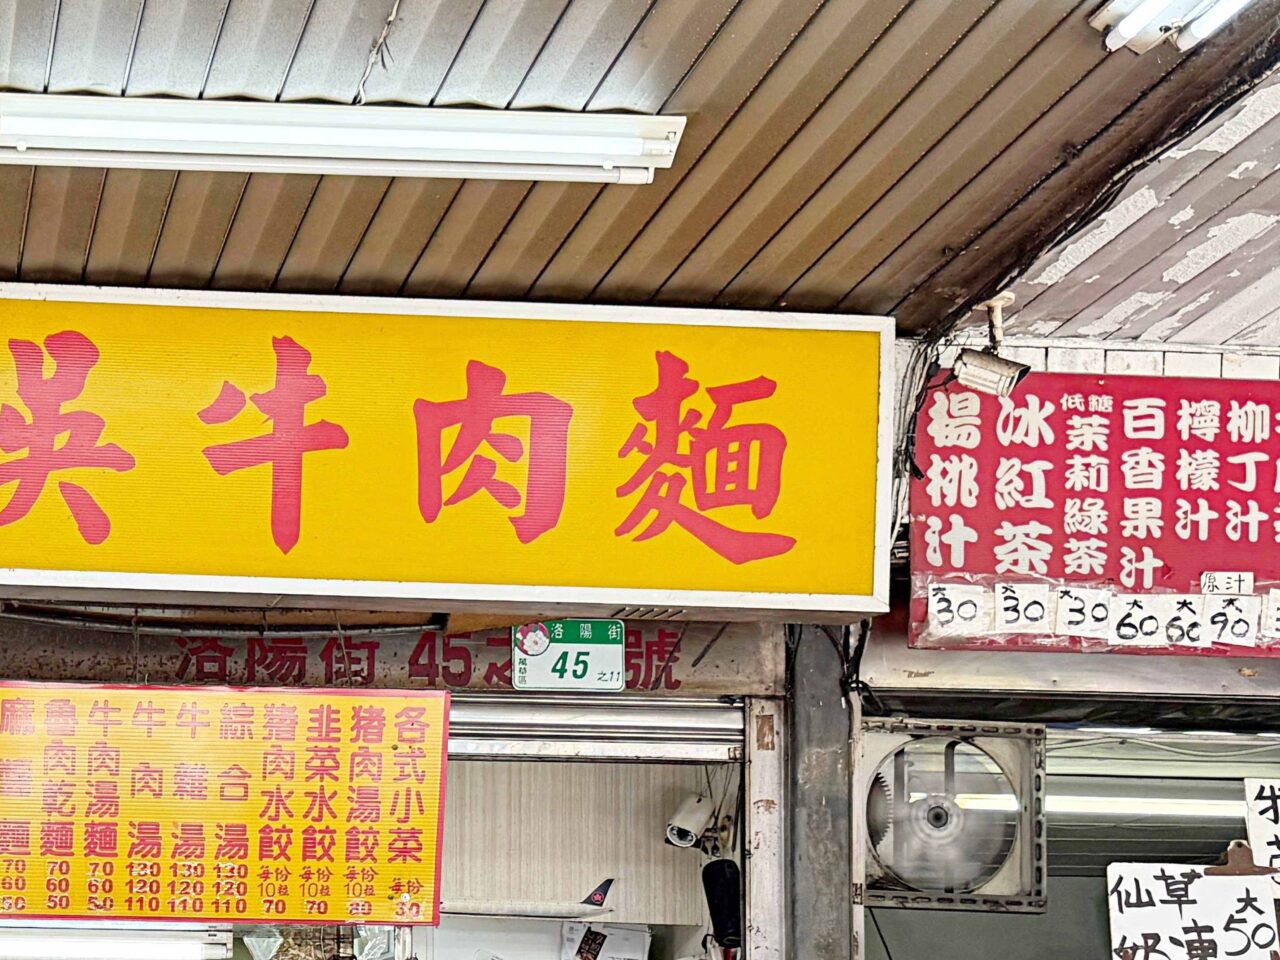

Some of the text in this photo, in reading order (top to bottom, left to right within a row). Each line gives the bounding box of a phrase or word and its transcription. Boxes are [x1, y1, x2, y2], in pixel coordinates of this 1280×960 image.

[1060, 393, 1114, 413] 低糖
[1175, 398, 1221, 541] 檸檬汁
[1225, 399, 1272, 543] 柳丁汁
[924, 391, 981, 568] 楊桃汁
[993, 394, 1055, 575] 冰紅茶
[1063, 414, 1110, 576] 茉莉綠茶
[1120, 397, 1166, 590] 百香果汁
[1203, 573, 1246, 592] 原汁
[936, 597, 978, 627] 30
[1004, 595, 1045, 624] 30
[1067, 596, 1109, 626] 30
[551, 623, 621, 640] 洛陽街
[1115, 611, 1159, 640] 60
[1210, 611, 1250, 640] 90
[175, 636, 380, 687] 洛陽街
[551, 651, 590, 679] 45
[597, 671, 621, 682] 之11
[40, 699, 79, 857] 魯肉乾麵
[84, 700, 123, 858] 牛肉湯麵
[127, 701, 167, 859] 牛肉湯
[214, 702, 255, 862] 綜合湯
[301, 703, 342, 863] 韭菜水餃
[387, 706, 430, 864] 各式小菜
[2, 859, 27, 874] 70
[47, 860, 70, 876] 70
[89, 861, 114, 877] 70
[125, 861, 161, 878] 130
[169, 862, 205, 878] 130
[213, 863, 249, 879] 130
[258, 865, 292, 882] 每份
[299, 865, 334, 882] 每份
[343, 866, 380, 882] 每份
[1, 876, 26, 891] 60
[46, 877, 70, 893] 60
[87, 879, 114, 894] 60
[124, 879, 161, 895] 120
[167, 880, 204, 896] 120
[212, 881, 248, 897] 120
[389, 877, 425, 894] 每份
[46, 895, 70, 910] 50
[1110, 868, 1204, 920] 仙草
[1235, 887, 1265, 915] 大
[0, 895, 26, 911] 50
[87, 896, 114, 912] 50
[124, 897, 160, 912] 110
[167, 898, 204, 913] 110
[211, 898, 248, 914] 110
[263, 899, 287, 915] 70
[305, 899, 329, 915] 70
[1223, 914, 1276, 957] 50
